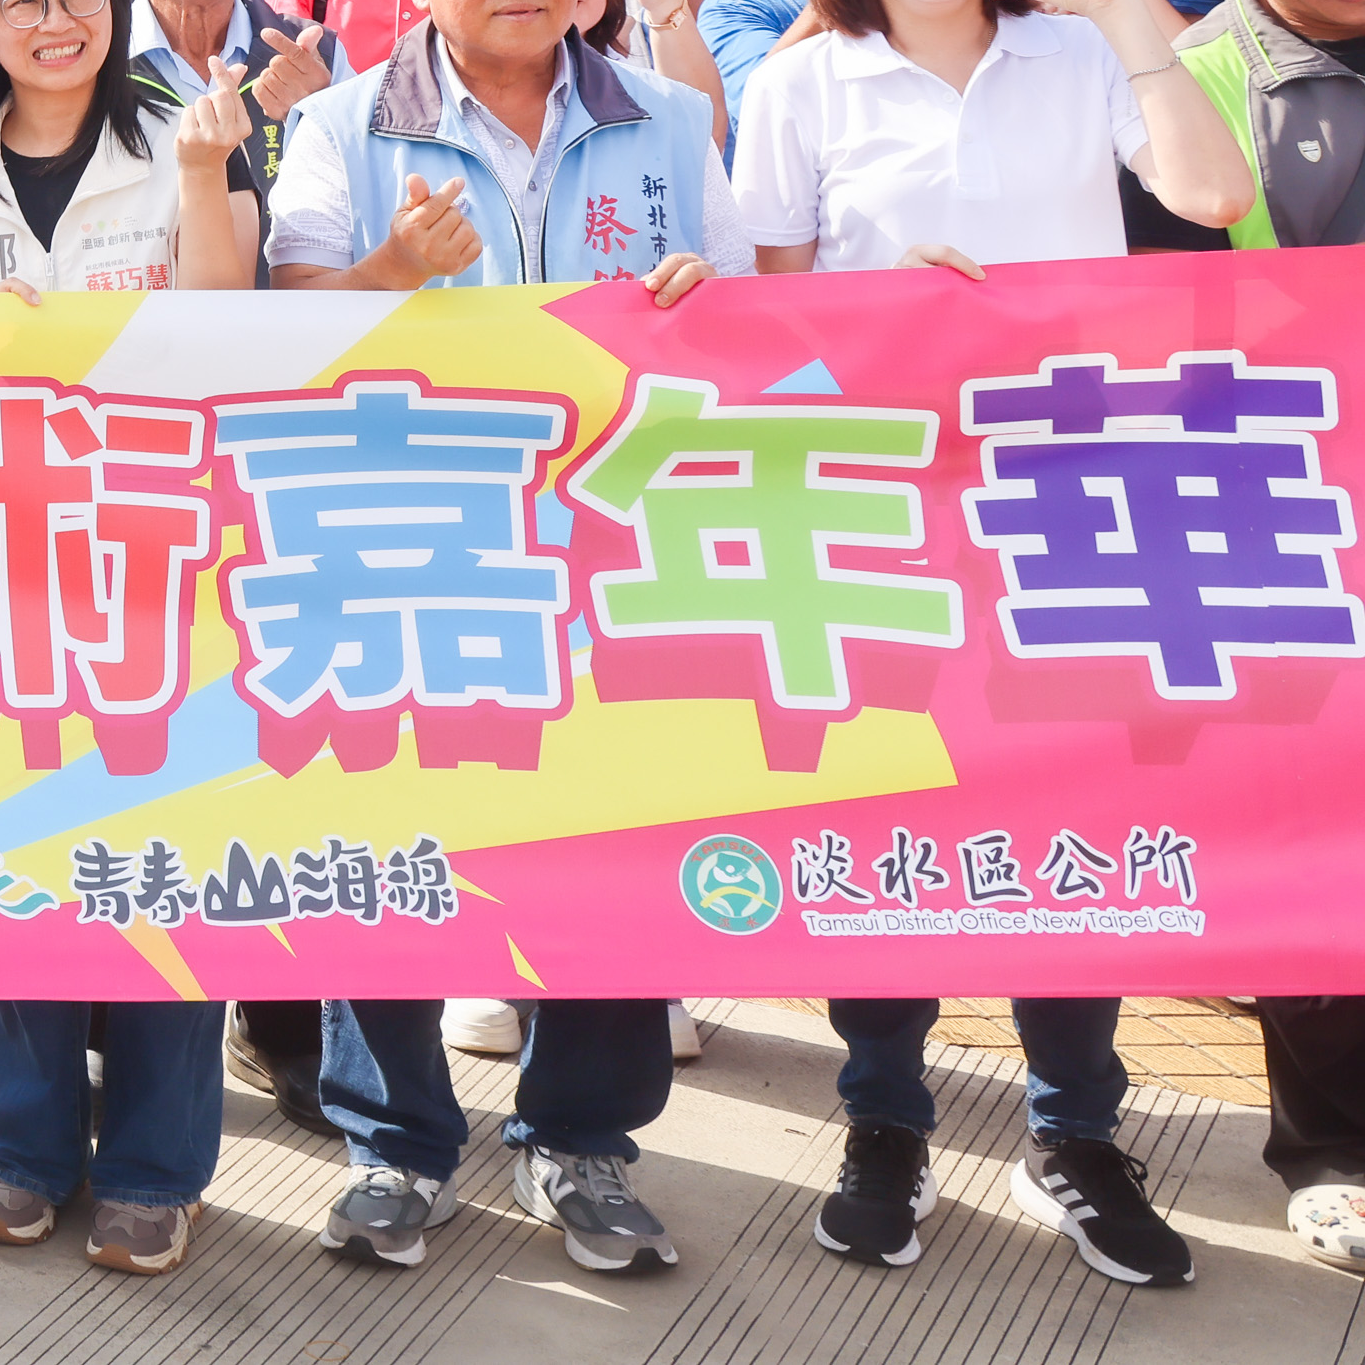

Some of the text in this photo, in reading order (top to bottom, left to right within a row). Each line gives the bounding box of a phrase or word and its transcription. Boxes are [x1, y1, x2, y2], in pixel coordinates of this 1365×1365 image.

[263, 125, 280, 178] 里長
[81, 226, 167, 250] 溫暖 創新 會做事
[641, 174, 668, 272] 新北市
[85, 264, 168, 290] 蘇巧慧
[691, 841, 766, 864] TAMSUI
[795, 830, 1191, 905] 淡水區公所
[72, 837, 455, 925] 青春山海線
[807, 910, 1202, 934] Tamsui District Office New Taipei City
